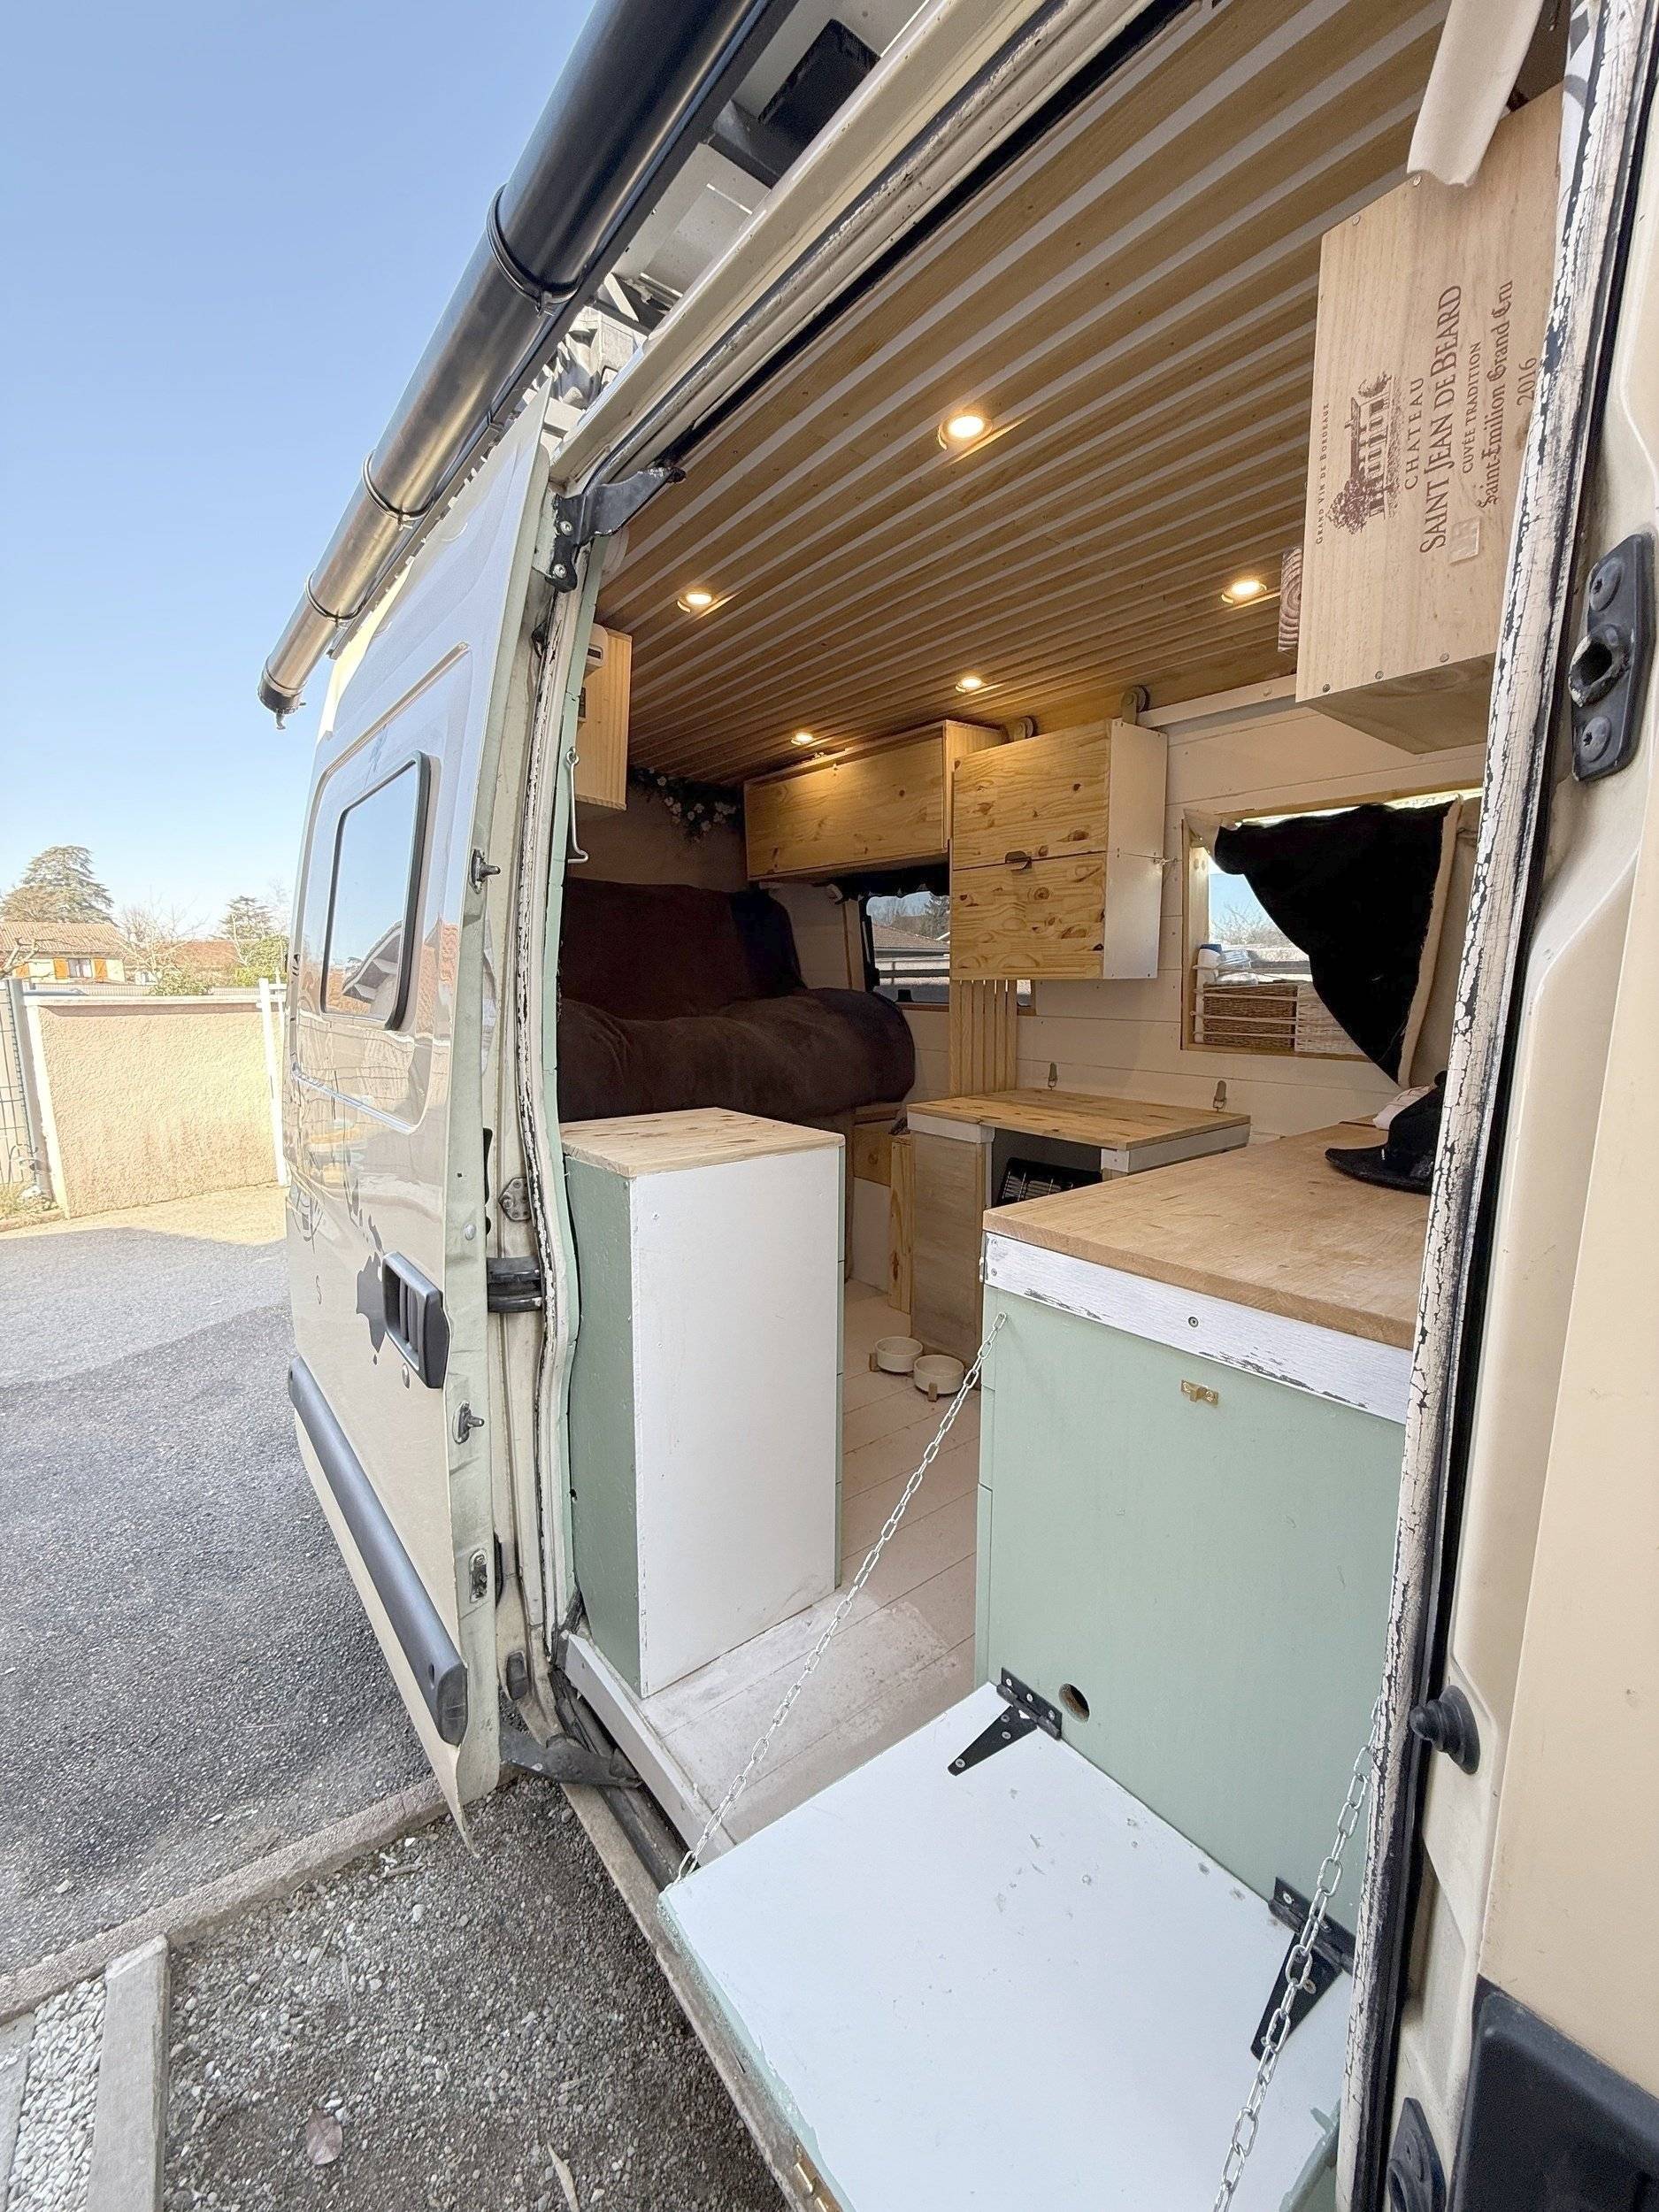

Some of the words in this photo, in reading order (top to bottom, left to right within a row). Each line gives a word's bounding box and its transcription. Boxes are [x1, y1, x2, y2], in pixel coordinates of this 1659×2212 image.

[1492, 280, 1513, 319] Cru
[1430, 286, 1461, 377] BEARD
[1486, 320, 1509, 381] Grand
[1434, 373, 1456, 411] DE
[1465, 342, 1481, 426] TRADITION
[1517, 357, 1537, 406] 2016
[1405, 378, 1424, 489] CHATEAU
[1424, 412, 1455, 474] JEAN
[1462, 428, 1475, 474] CUVÉE
[1477, 384, 1505, 509] Saint-Emilion
[1419, 477, 1449, 553] SAINT
